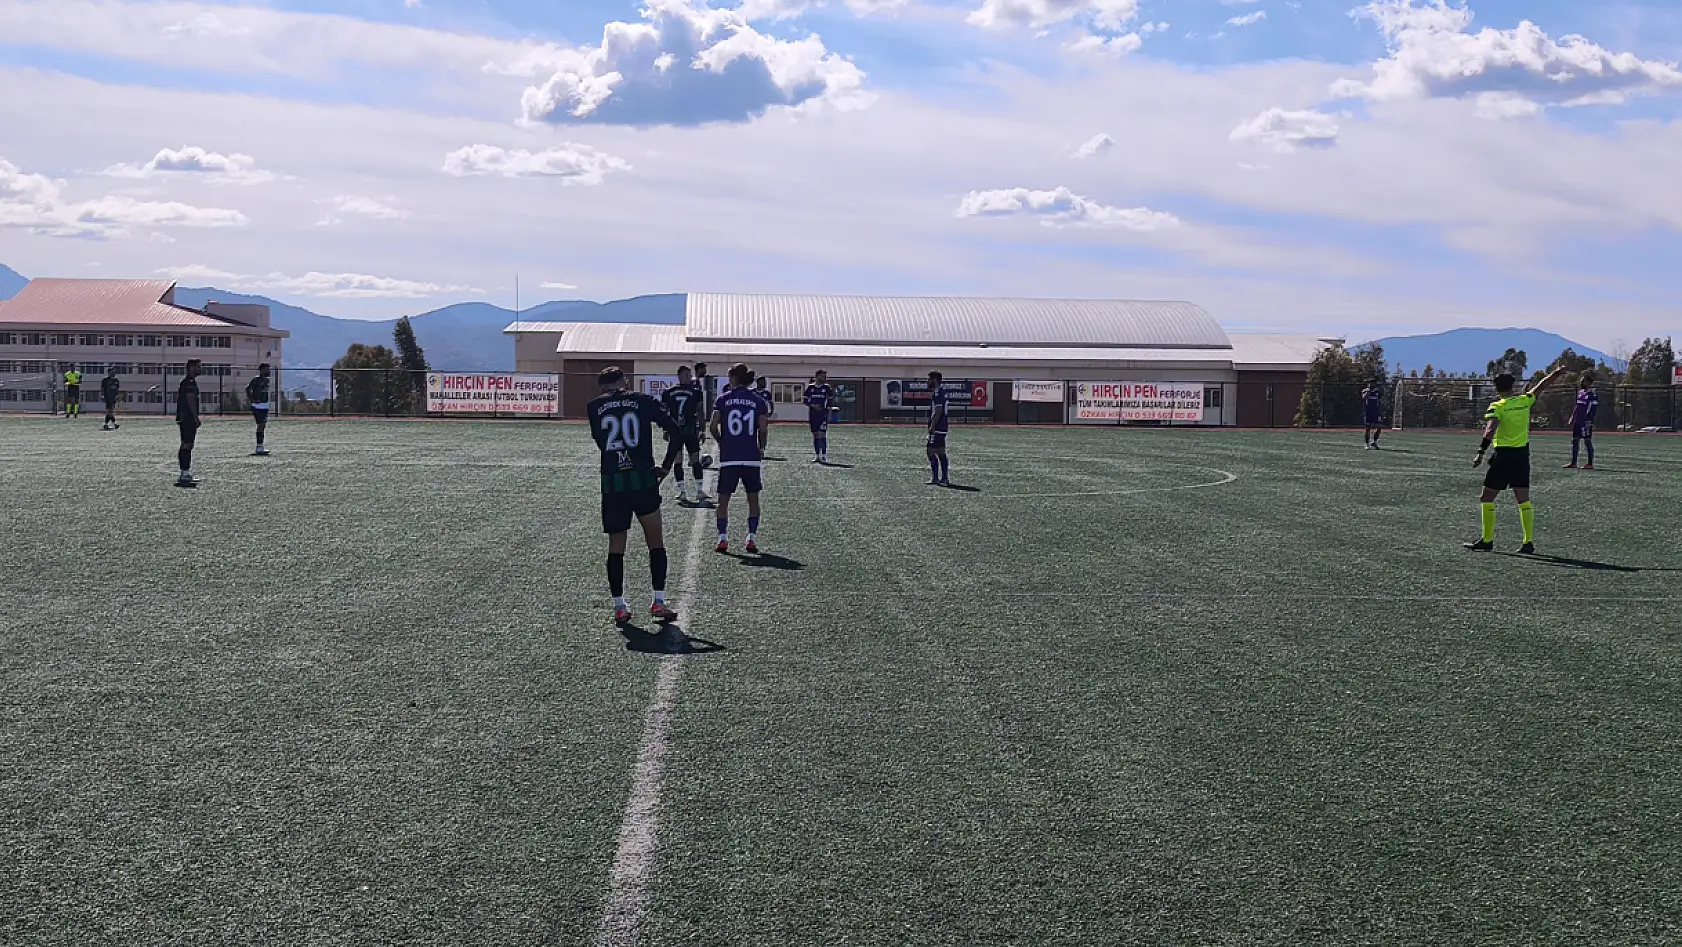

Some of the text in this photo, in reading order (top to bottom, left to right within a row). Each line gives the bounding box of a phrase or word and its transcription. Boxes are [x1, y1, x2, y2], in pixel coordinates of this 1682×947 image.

[444, 376, 558, 391] HIRÇIN PEN FERFORJE
[430, 391, 557, 401] MAHALLELER ARASI FUTBOL TURNUVASI
[1092, 384, 1200, 399] HIRÇIN PEN FERFORJE
[432, 402, 458, 411] ÖZKAN
[676, 396, 688, 415] 7
[1078, 399, 1200, 409] TÜM TAKIMLARIMIZA BAŞARILAR DİLERİZ
[1081, 410, 1106, 418] ÖZKAN
[728, 409, 755, 436] 61
[601, 411, 640, 451] 20
